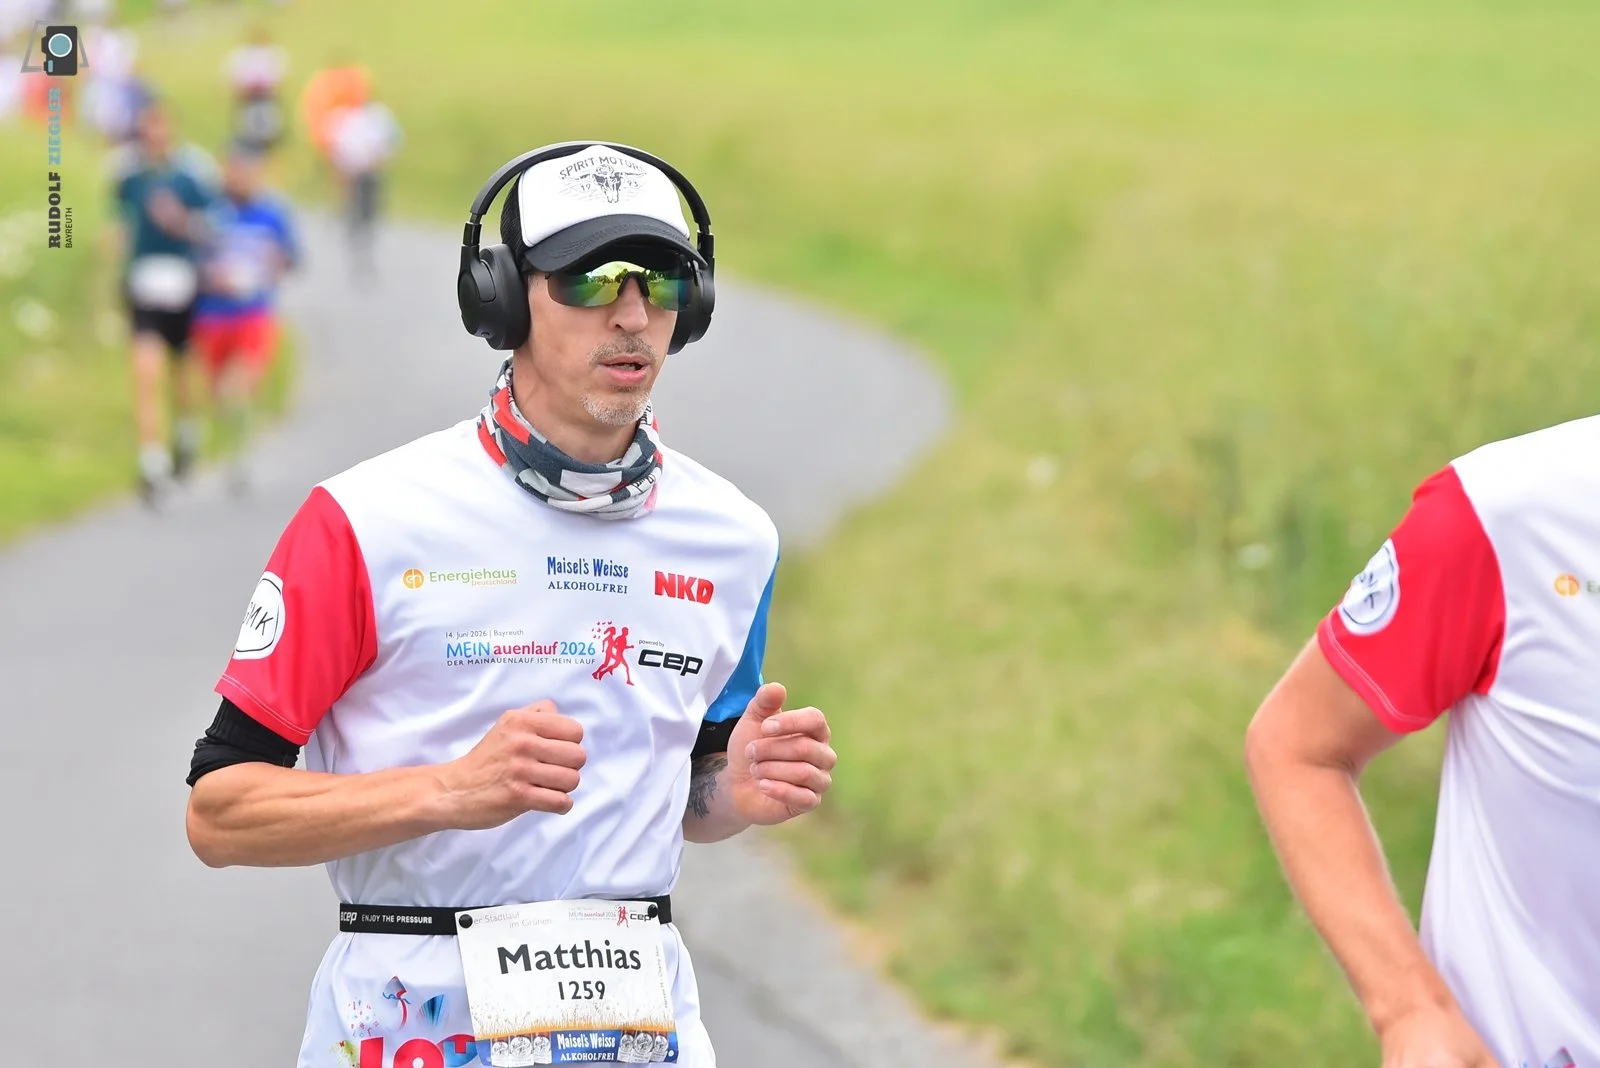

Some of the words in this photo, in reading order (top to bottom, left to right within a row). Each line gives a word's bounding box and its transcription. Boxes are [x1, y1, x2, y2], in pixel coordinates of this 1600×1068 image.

[560, 157, 595, 180] SPIRIT
[547, 556, 590, 575] Maisel's
[593, 558, 629, 578] Weisse
[429, 568, 517, 583] Energiehaus
[471, 578, 517, 586] Deutschland
[547, 581, 628, 594] ALKOHOLFREI
[654, 570, 715, 605] NKD
[445, 631, 455, 639] 14.
[456, 631, 469, 640] Juni
[470, 630, 487, 638] 2026
[493, 629, 524, 638] Bayreuth
[446, 641, 490, 659] MEIN
[493, 641, 559, 655] auenlauf
[560, 641, 596, 656] 2026
[638, 639, 659, 647] powered
[467, 657, 535, 665] MAINAUENLAUF
[638, 649, 704, 676] cep
[361, 913, 381, 922] ENJOY
[382, 914, 395, 923] THE
[396, 915, 433, 924] PRESSURE
[484, 911, 520, 923] Stadtlauf
[497, 939, 642, 974] Matthias
[558, 980, 606, 1000] 1259
[556, 1033, 590, 1050] Maisel's
[590, 1032, 616, 1048] Weisse
[560, 1052, 615, 1061] ALKOHOLFREI
